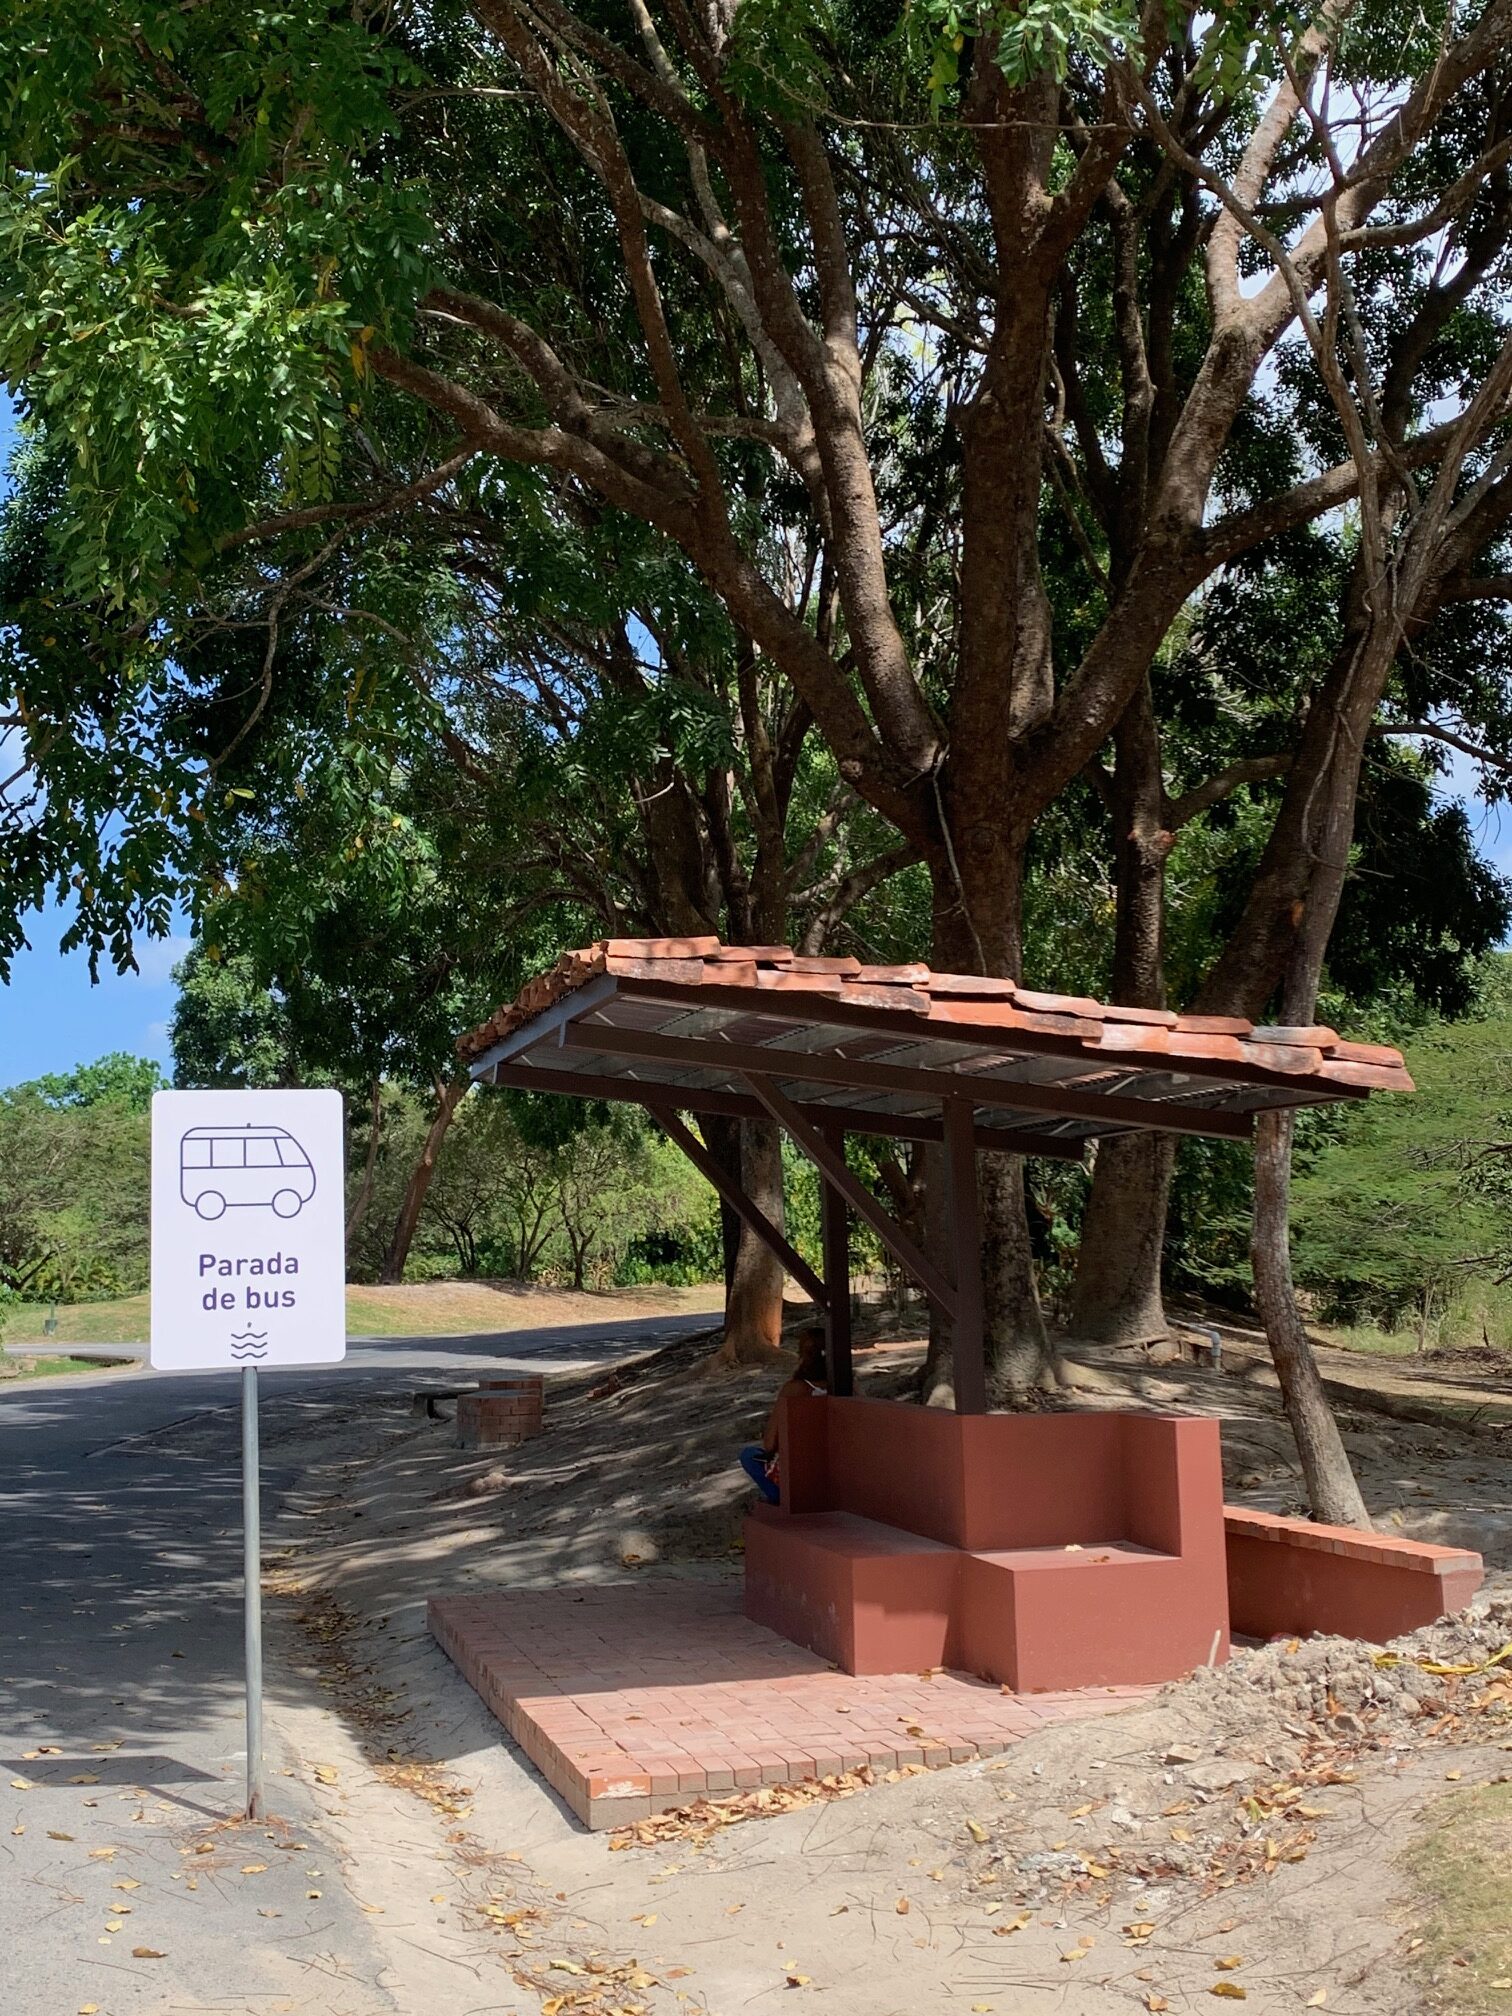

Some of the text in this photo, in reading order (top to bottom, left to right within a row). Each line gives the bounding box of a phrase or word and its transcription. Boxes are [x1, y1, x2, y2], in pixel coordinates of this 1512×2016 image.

[199, 1251, 299, 1277] Parada
[202, 1286, 296, 1311] de bus
